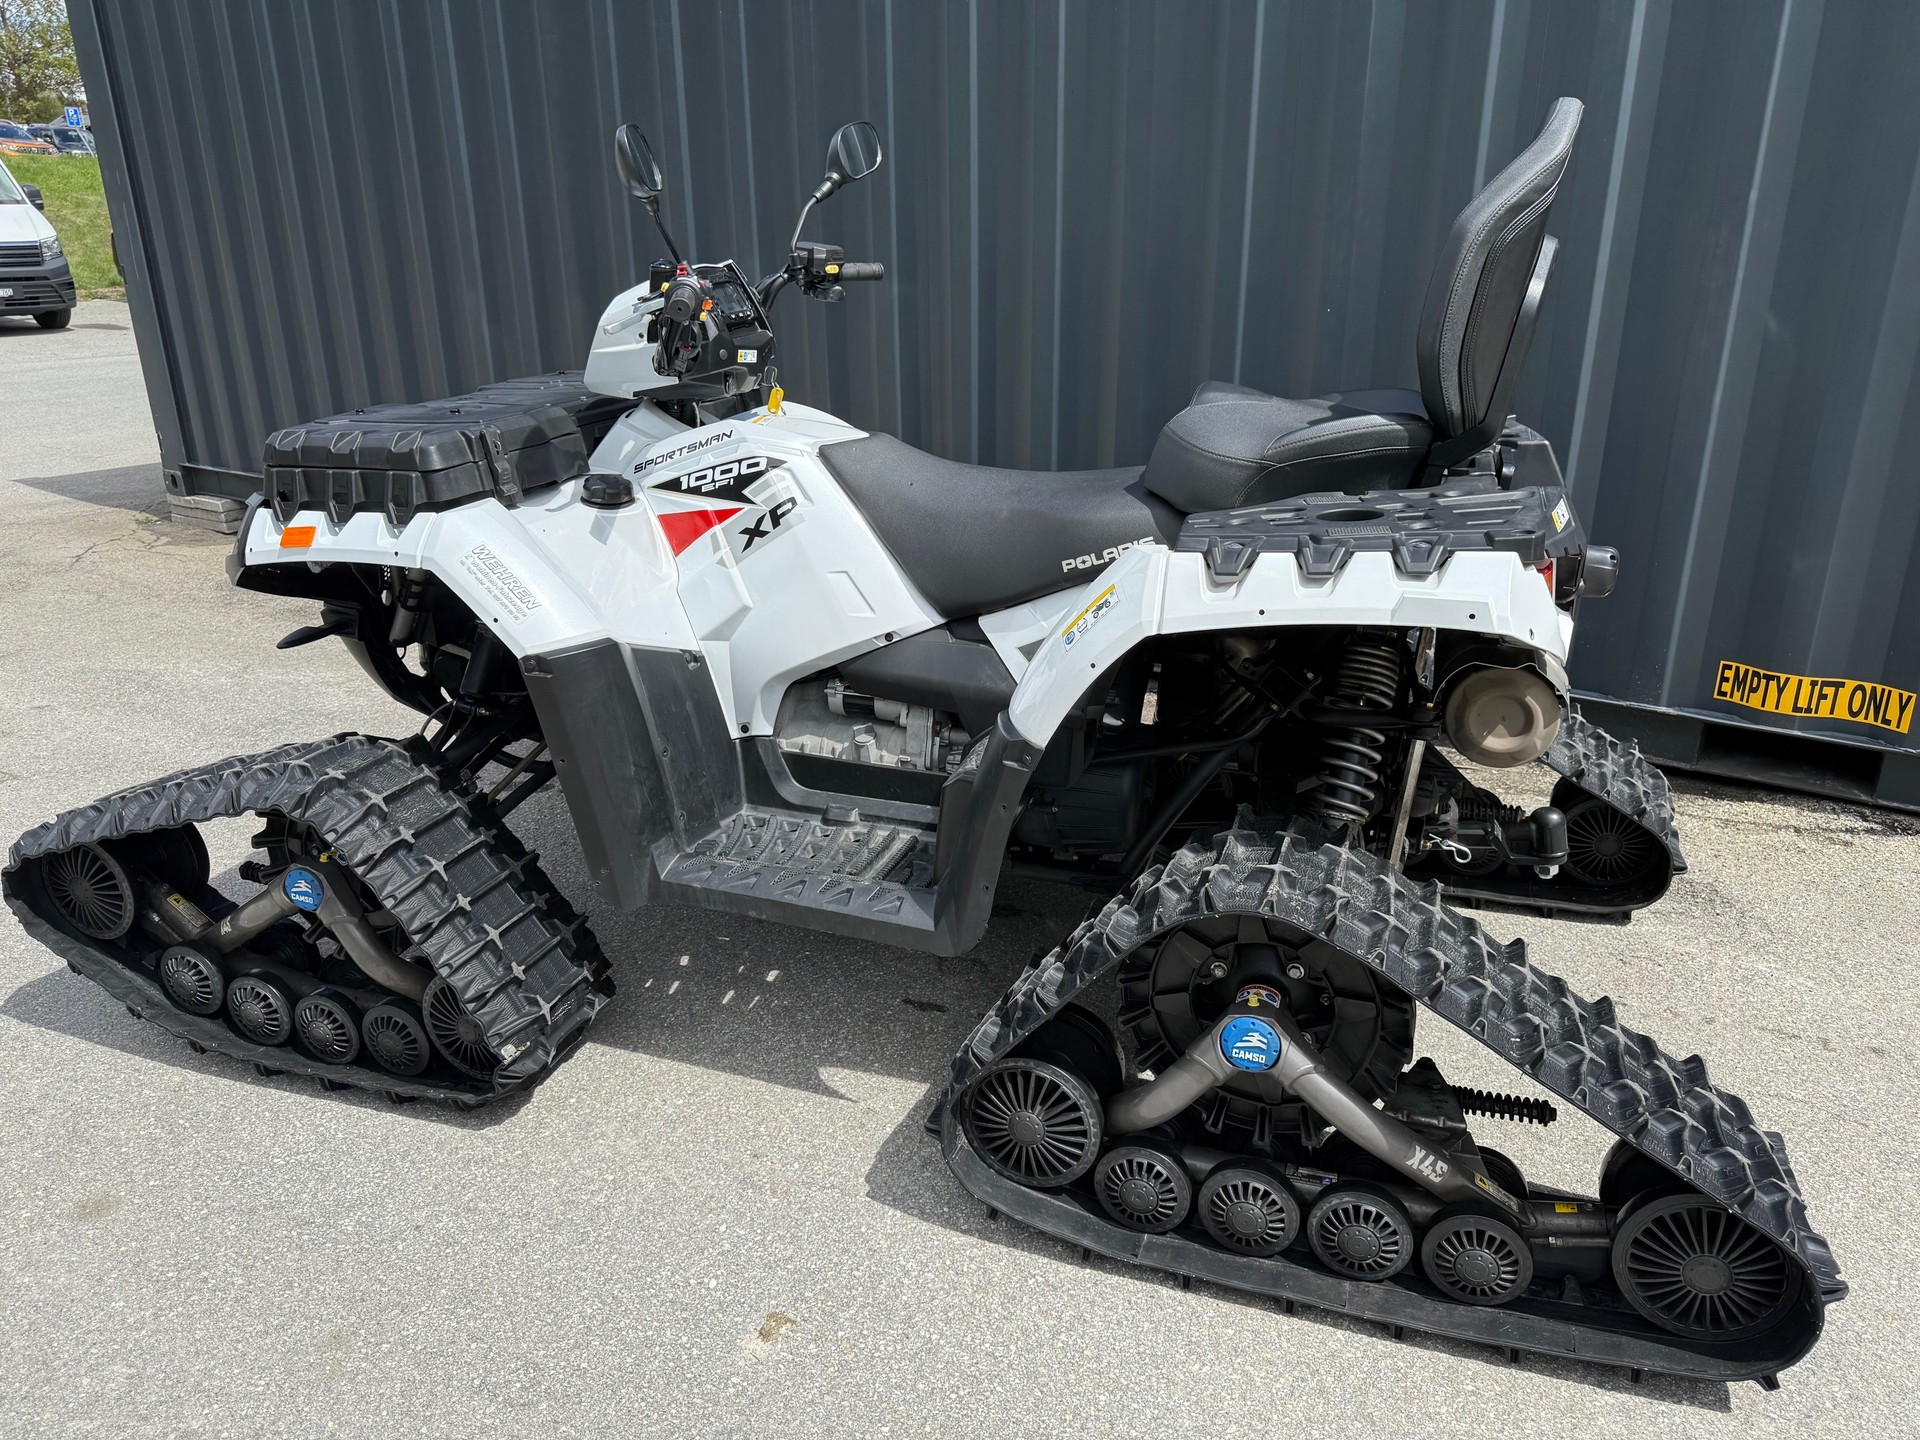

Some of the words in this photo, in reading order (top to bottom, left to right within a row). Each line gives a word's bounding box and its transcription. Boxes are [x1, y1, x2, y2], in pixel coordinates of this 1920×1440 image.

[633, 429, 734, 475] SPORTSMAN
[680, 456, 768, 490] 1000
[701, 478, 734, 493] EFI
[738, 496, 799, 554] XP
[471, 543, 542, 611] WEHREN
[1716, 663, 1791, 711] EMPTY
[1791, 678, 1846, 716] LIFT
[1847, 683, 1913, 730] ONLY
[290, 893, 314, 904] CAMSO
[1232, 1048, 1266, 1064] CAMSO
[1405, 1145, 1448, 1183] X4S
